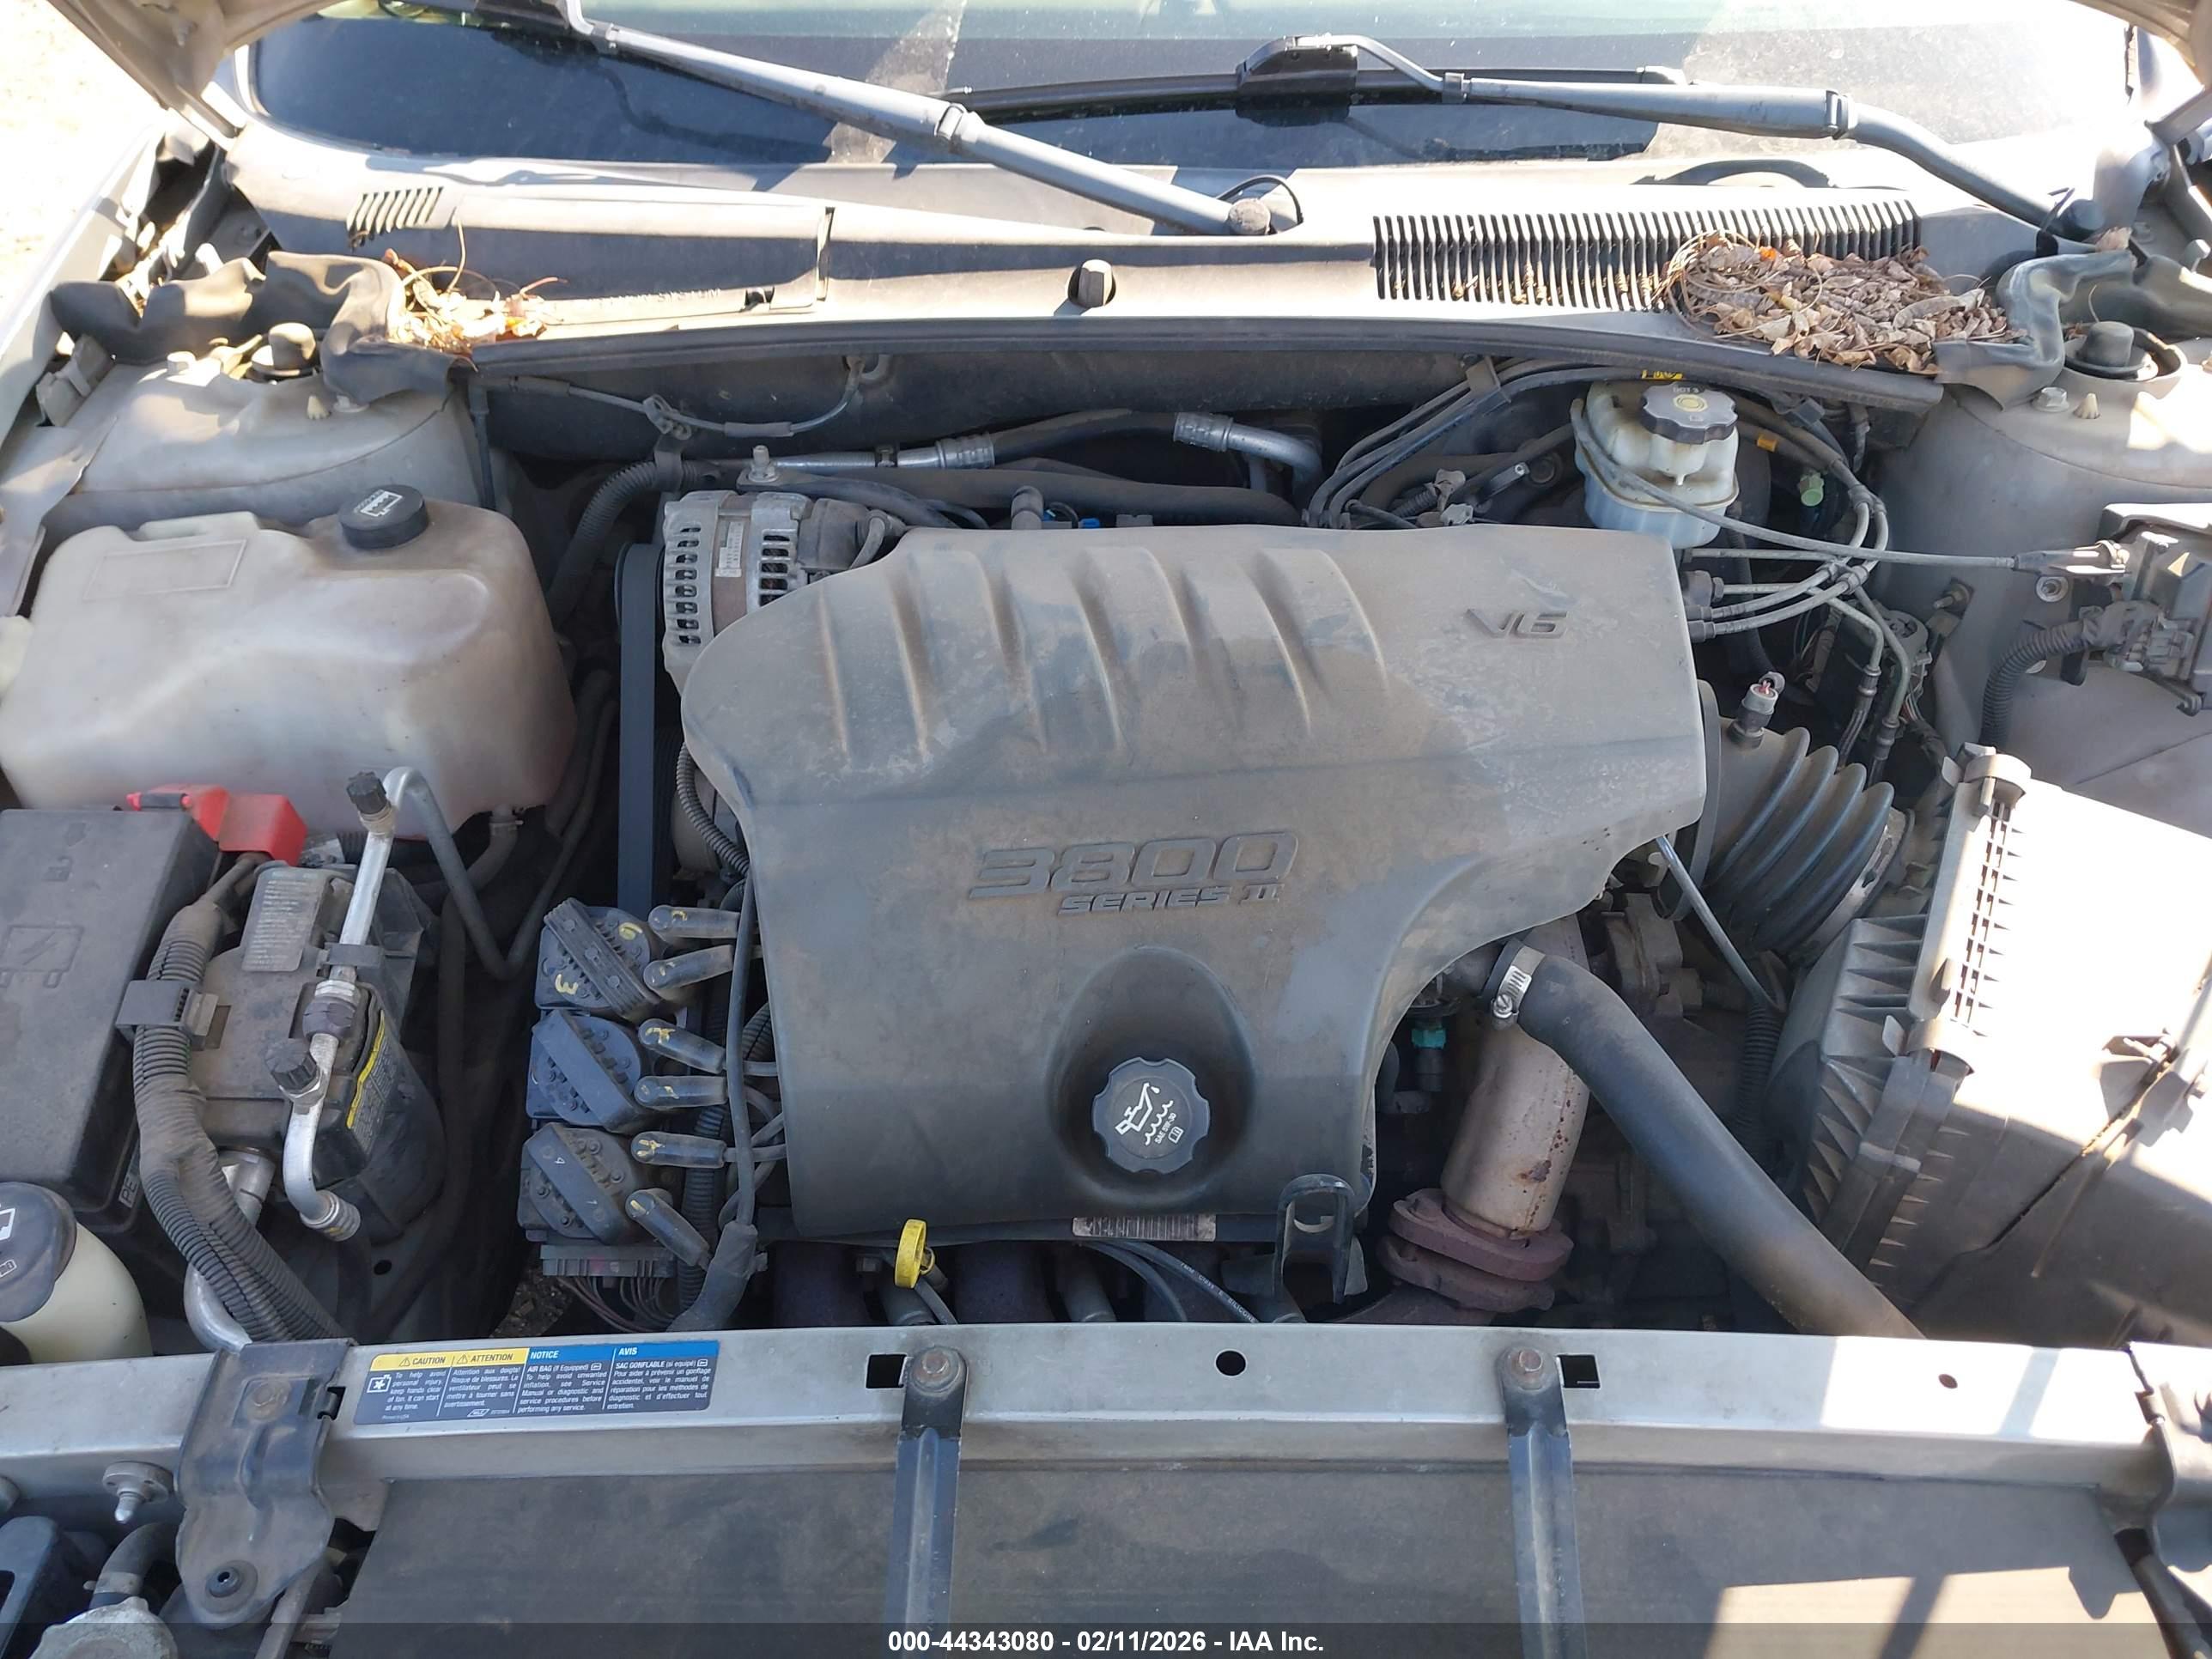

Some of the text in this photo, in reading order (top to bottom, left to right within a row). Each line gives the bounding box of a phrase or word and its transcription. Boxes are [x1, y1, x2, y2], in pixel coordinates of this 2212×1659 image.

[1463, 609, 1568, 639] V6
[969, 831, 1298, 899] 3800
[1057, 884, 1285, 916] SERIES II
[1154, 1130, 1166, 1144] SAE
[530, 1350, 560, 1359] NOTICE
[618, 1347, 638, 1356] AVIS
[471, 1353, 514, 1362] ATTENTION
[685, 1367, 712, 1376] gonflage
[557, 1388, 589, 1396] diagnostic
[608, 1394, 641, 1402] diagnostic
[516, 1406, 550, 1414] performing
